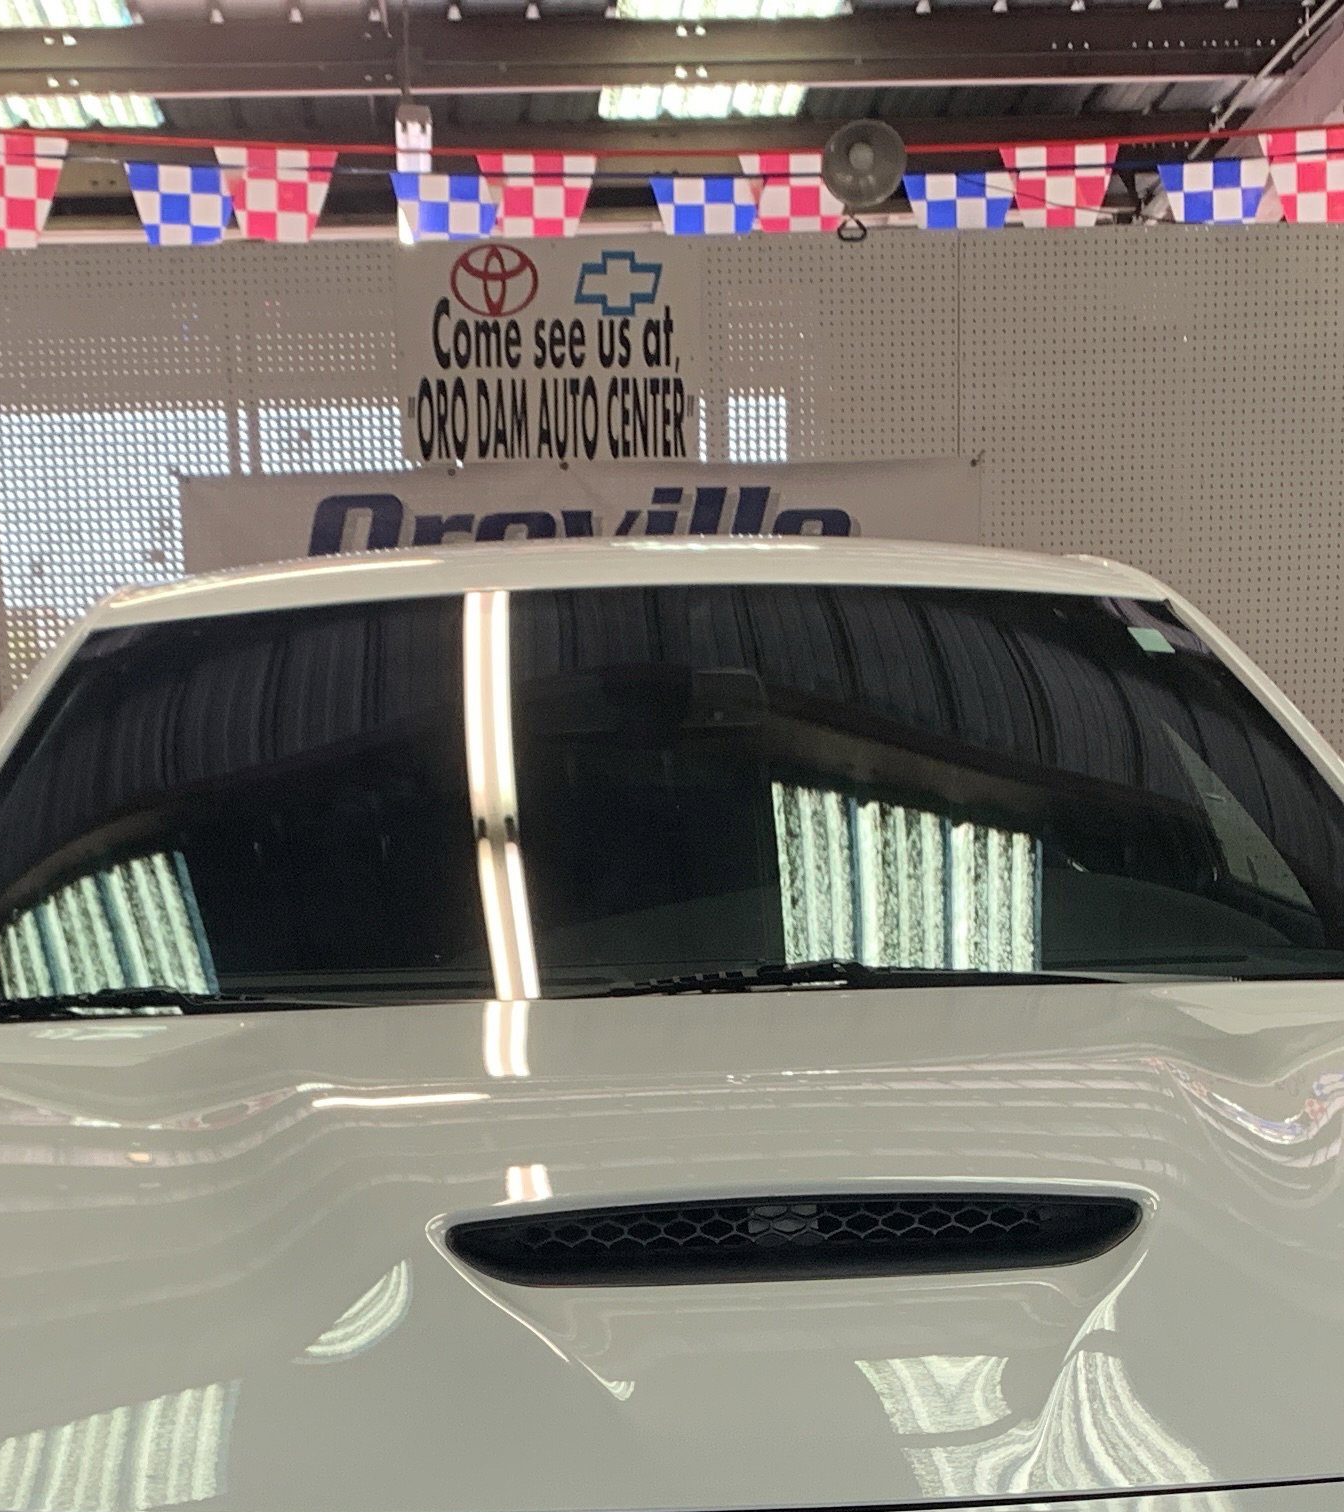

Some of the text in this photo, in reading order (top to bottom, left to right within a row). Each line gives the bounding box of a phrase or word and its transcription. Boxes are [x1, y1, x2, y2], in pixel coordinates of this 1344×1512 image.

[433, 297, 522, 370] Come
[534, 318, 586, 369] see
[597, 318, 632, 369] us
[476, 377, 530, 459] DAM
[537, 375, 599, 461] AUTO
